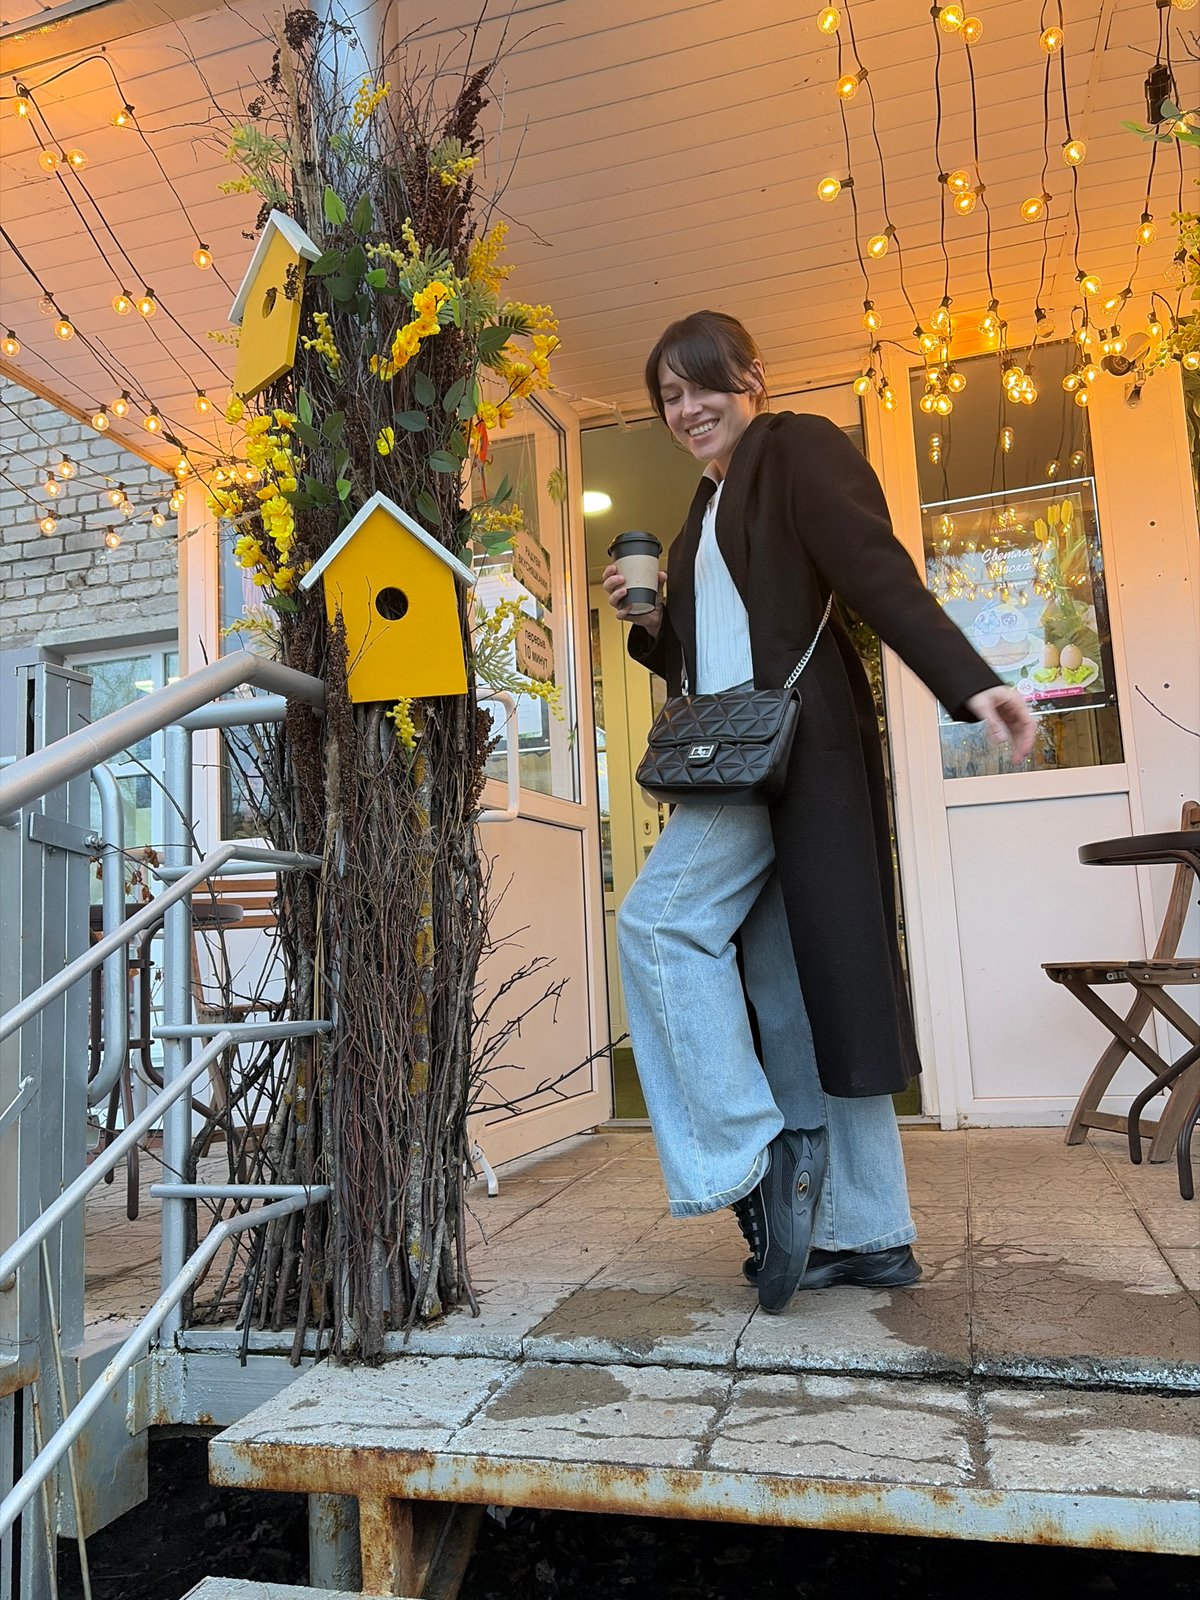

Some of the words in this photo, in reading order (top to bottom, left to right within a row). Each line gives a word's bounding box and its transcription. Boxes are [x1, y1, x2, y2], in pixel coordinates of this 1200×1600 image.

[981, 547, 1039, 564] Светлая
[525, 629, 545, 650] перерыв
[524, 643, 532, 660] 10
[532, 651, 548, 671] минут
